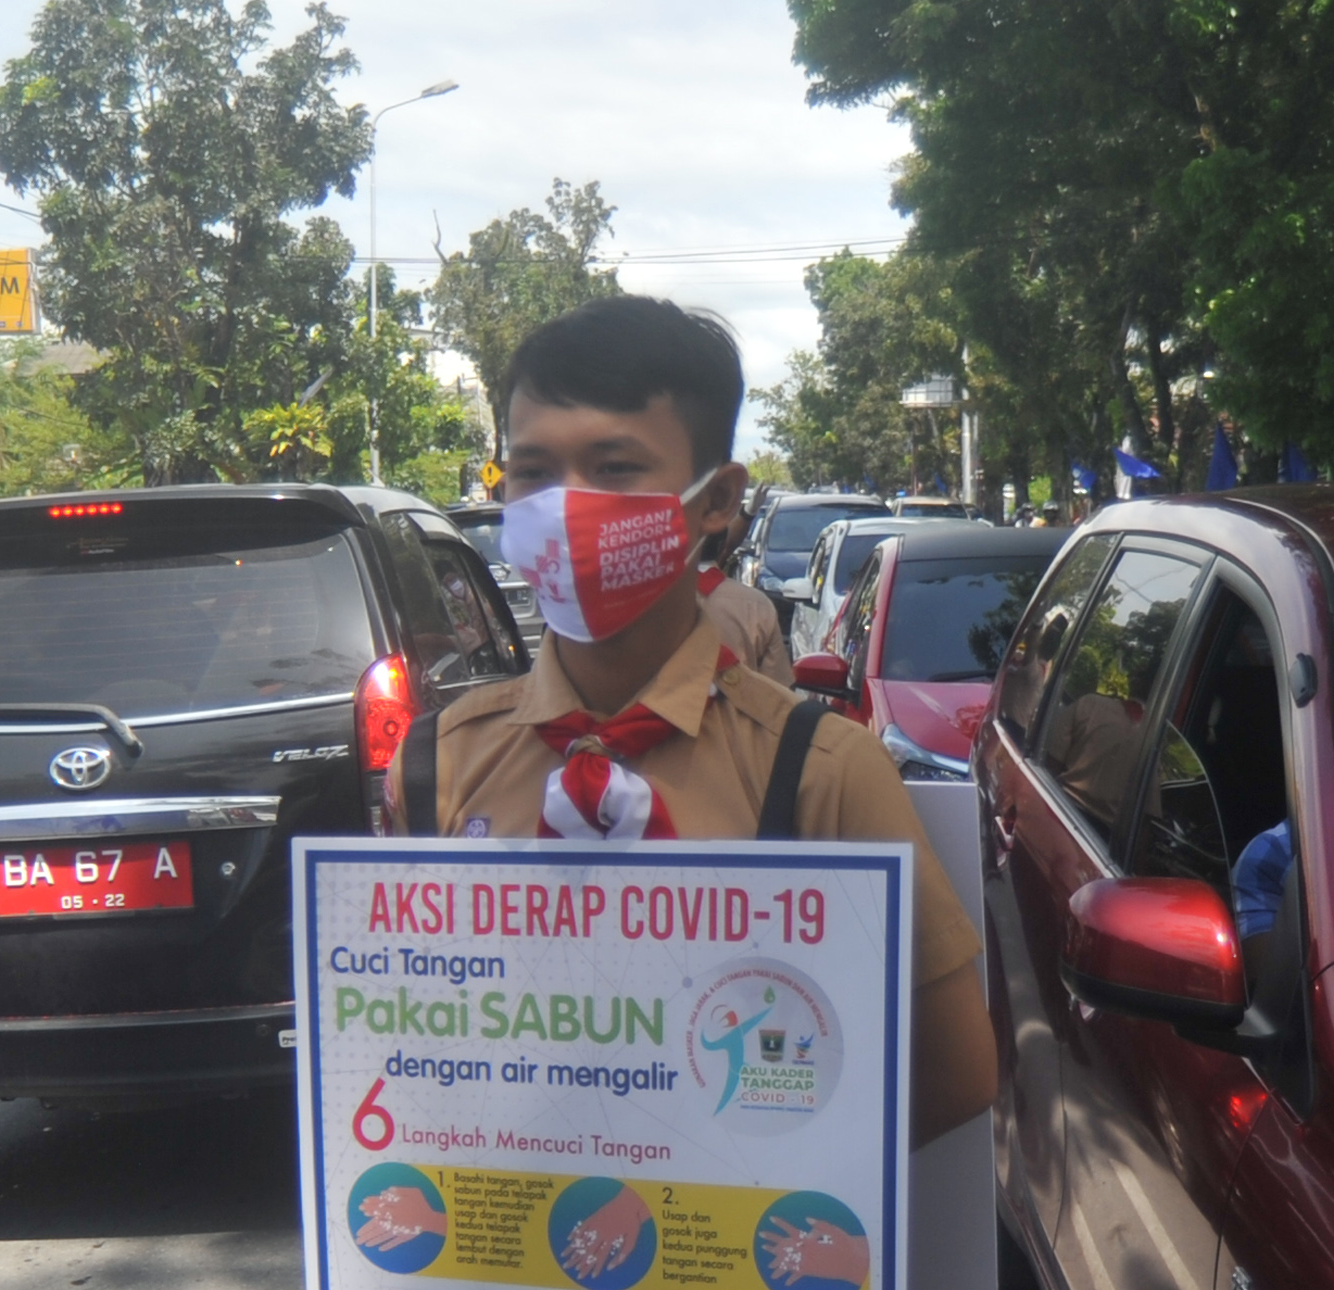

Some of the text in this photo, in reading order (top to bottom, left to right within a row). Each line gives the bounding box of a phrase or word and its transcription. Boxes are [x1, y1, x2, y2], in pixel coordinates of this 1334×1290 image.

[599, 535, 680, 566] DISIPLIN
[273, 744, 349, 762] VELOZ
[4, 848, 177, 887] BA 67 A
[61, 896, 83, 909] 05
[105, 894, 125, 907] 22
[369, 882, 824, 945] AKSI DERAP COVID-19
[330, 946, 505, 985] Cuci Tangan
[336, 985, 663, 1046] Pakai SABUN
[385, 1049, 678, 1097] dengan air mengalir
[741, 1067, 813, 1079] AKU KADER
[741, 1077, 814, 1091] TANGGAP
[741, 1092, 785, 1103] COVID
[801, 1095, 814, 1104] 19
[352, 1076, 671, 1164] 6 Langkah Mencuci Tangan
[438, 1171, 450, 1188] 1.
[454, 1172, 484, 1183] Basahi
[526, 1177, 554, 1190] gosok
[454, 1184, 546, 1201] sabun pada telapak
[662, 1187, 679, 1205] 2.
[454, 1197, 535, 1210] tangan kemudian
[455, 1209, 528, 1223] usap dan gosok
[662, 1210, 710, 1223] Usap dan
[455, 1218, 520, 1234] kedua telapak
[662, 1225, 717, 1241] gosok juga
[456, 1232, 522, 1245] tangan secara
[456, 1241, 524, 1259] lembut dengan
[662, 1239, 747, 1259] kedua punggung
[456, 1254, 477, 1264] arah
[662, 1256, 734, 1270] tangan secara
[662, 1269, 717, 1284] bergantian
